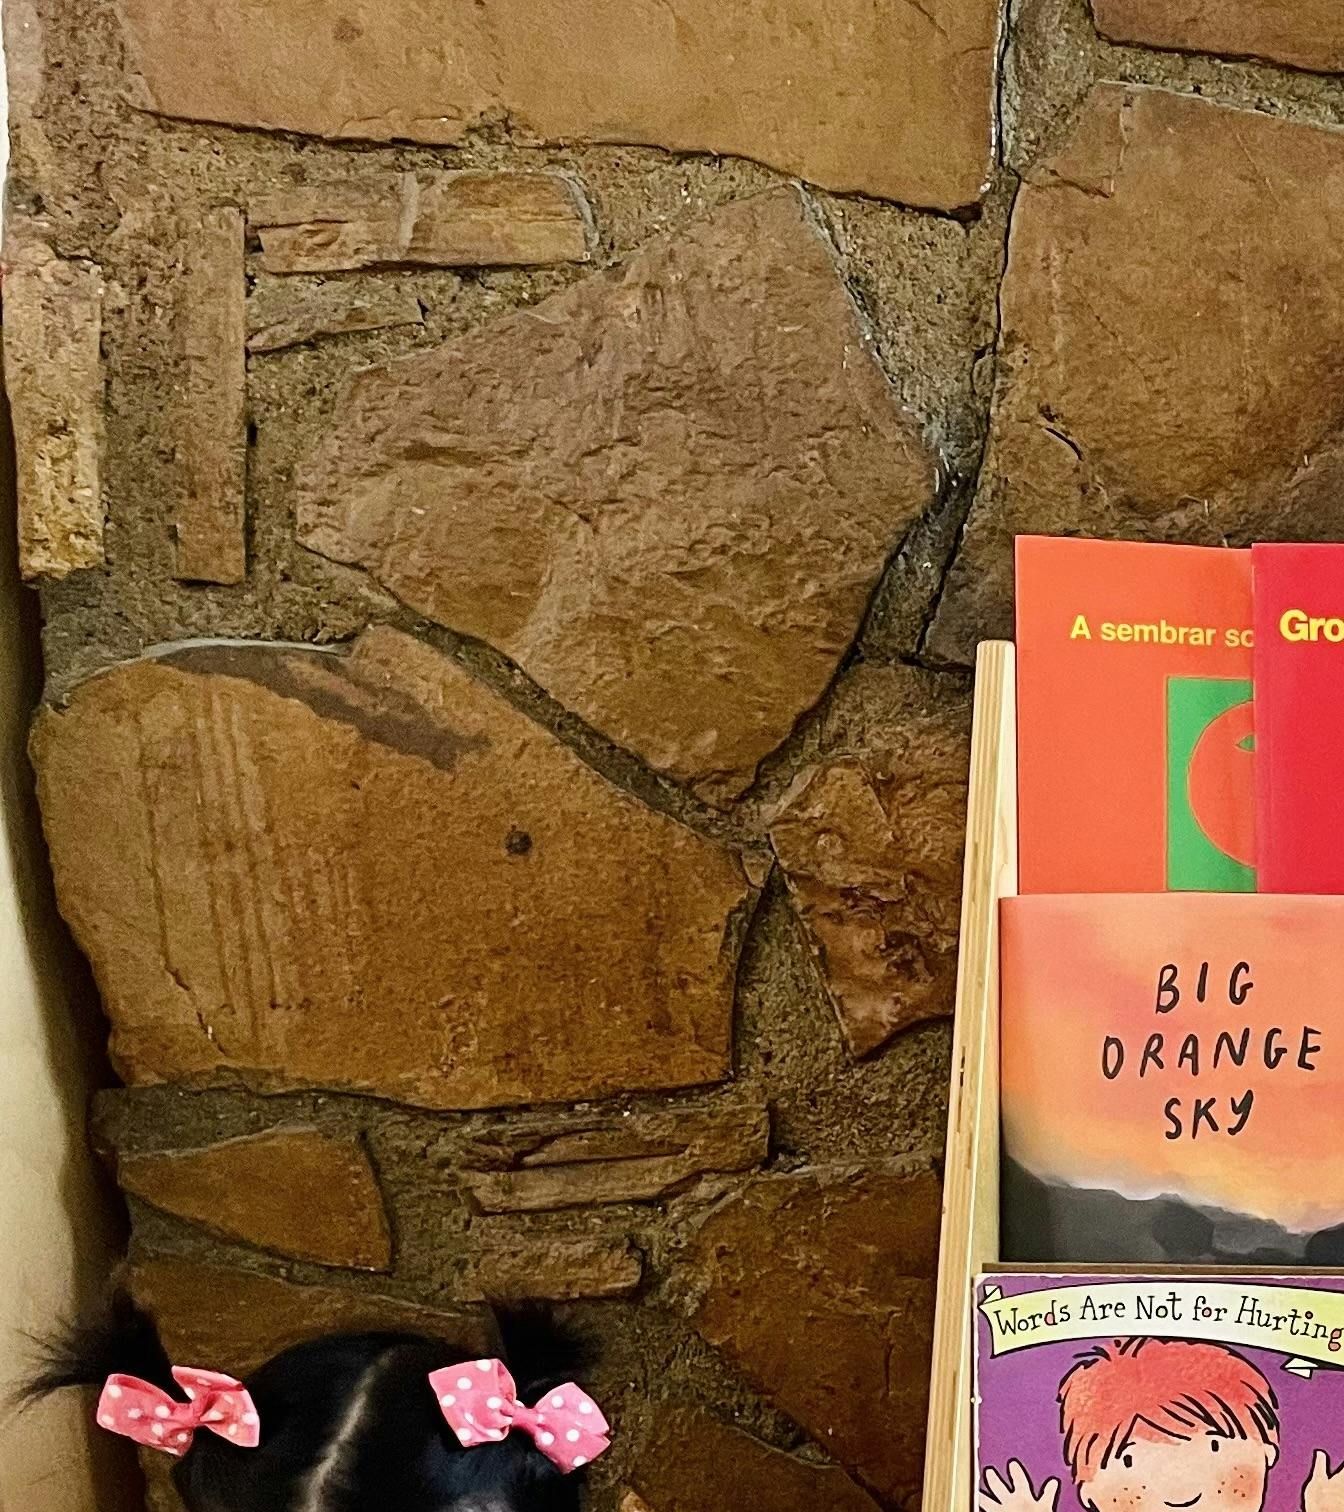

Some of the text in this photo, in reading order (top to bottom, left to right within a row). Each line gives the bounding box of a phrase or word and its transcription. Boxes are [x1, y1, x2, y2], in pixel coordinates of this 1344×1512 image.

[1070, 615, 1091, 639] A
[1101, 620, 1216, 647] sembrar
[1155, 961, 1255, 1014] BIG
[1101, 1026, 1322, 1079] ORANGE
[1164, 1089, 1255, 1139] SKY
[994, 1292, 1344, 1351] Words Are Not for Hurting
